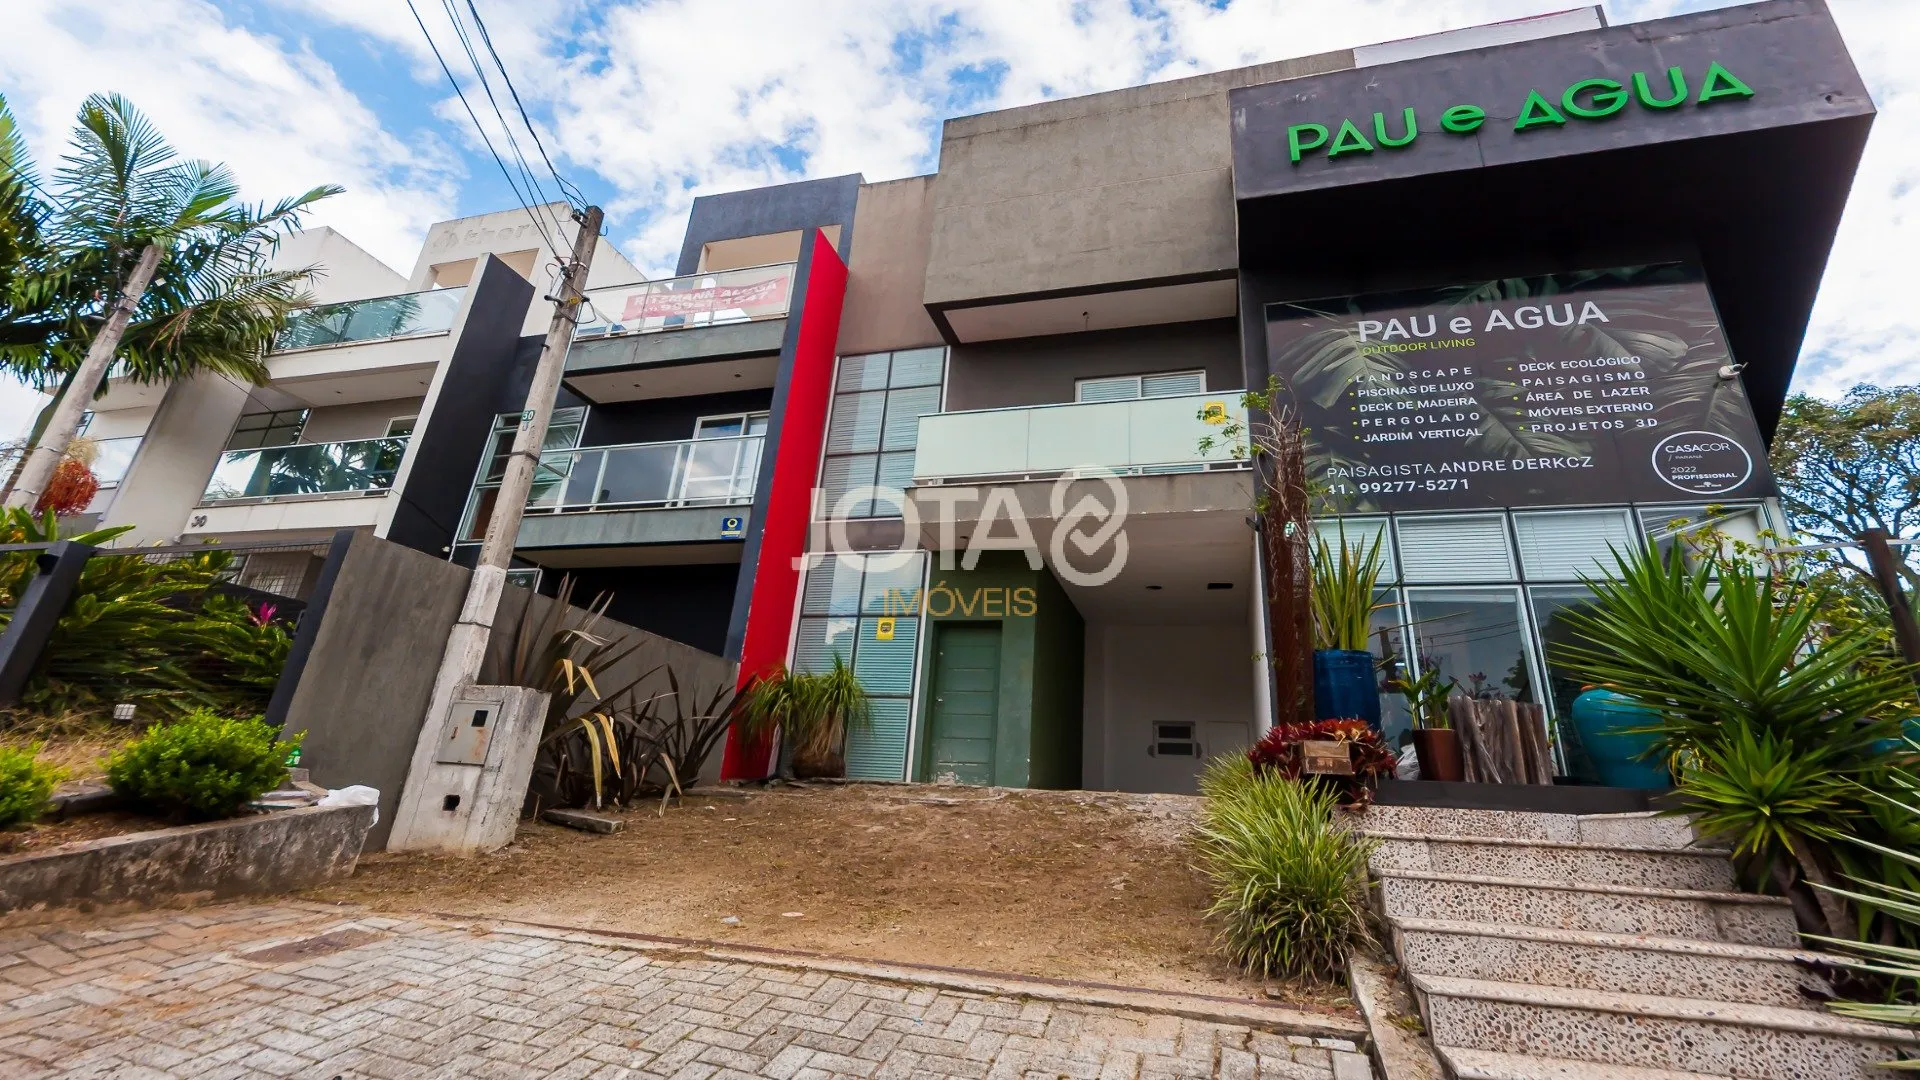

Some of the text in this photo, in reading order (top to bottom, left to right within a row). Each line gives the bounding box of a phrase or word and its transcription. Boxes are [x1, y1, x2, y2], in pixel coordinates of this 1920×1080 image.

[1287, 60, 1755, 164] PAU e AGUA
[1358, 300, 1610, 343] PAU e AGUA
[1362, 338, 1476, 356] OUTDOOR LIVING
[1519, 355, 1642, 373] DECK ECOLÓGICO
[1355, 366, 1473, 383] LANDSCAPE
[1521, 370, 1646, 388] PAISAGISMO
[1357, 381, 1475, 398] PISCINAS DE LUXO
[1525, 385, 1651, 403] ÁREA DE LAZER
[1359, 396, 1478, 413] DECK DE MADEIRA
[1528, 402, 1654, 418] MÓVEIS EXTERNO
[1361, 412, 1480, 428] PERGOLADO
[1531, 417, 1659, 434] PROJETOS 3D
[1362, 427, 1484, 443] JARDIM VERTICAL
[1664, 442, 1731, 454] CASACOR
[1326, 455, 1595, 479] PAISAGISTA ANDRE DERKCZ
[1670, 465, 1698, 474] 2022
[1671, 472, 1739, 481] PROFISSIONAL
[1359, 478, 1470, 494] 99277-5271
